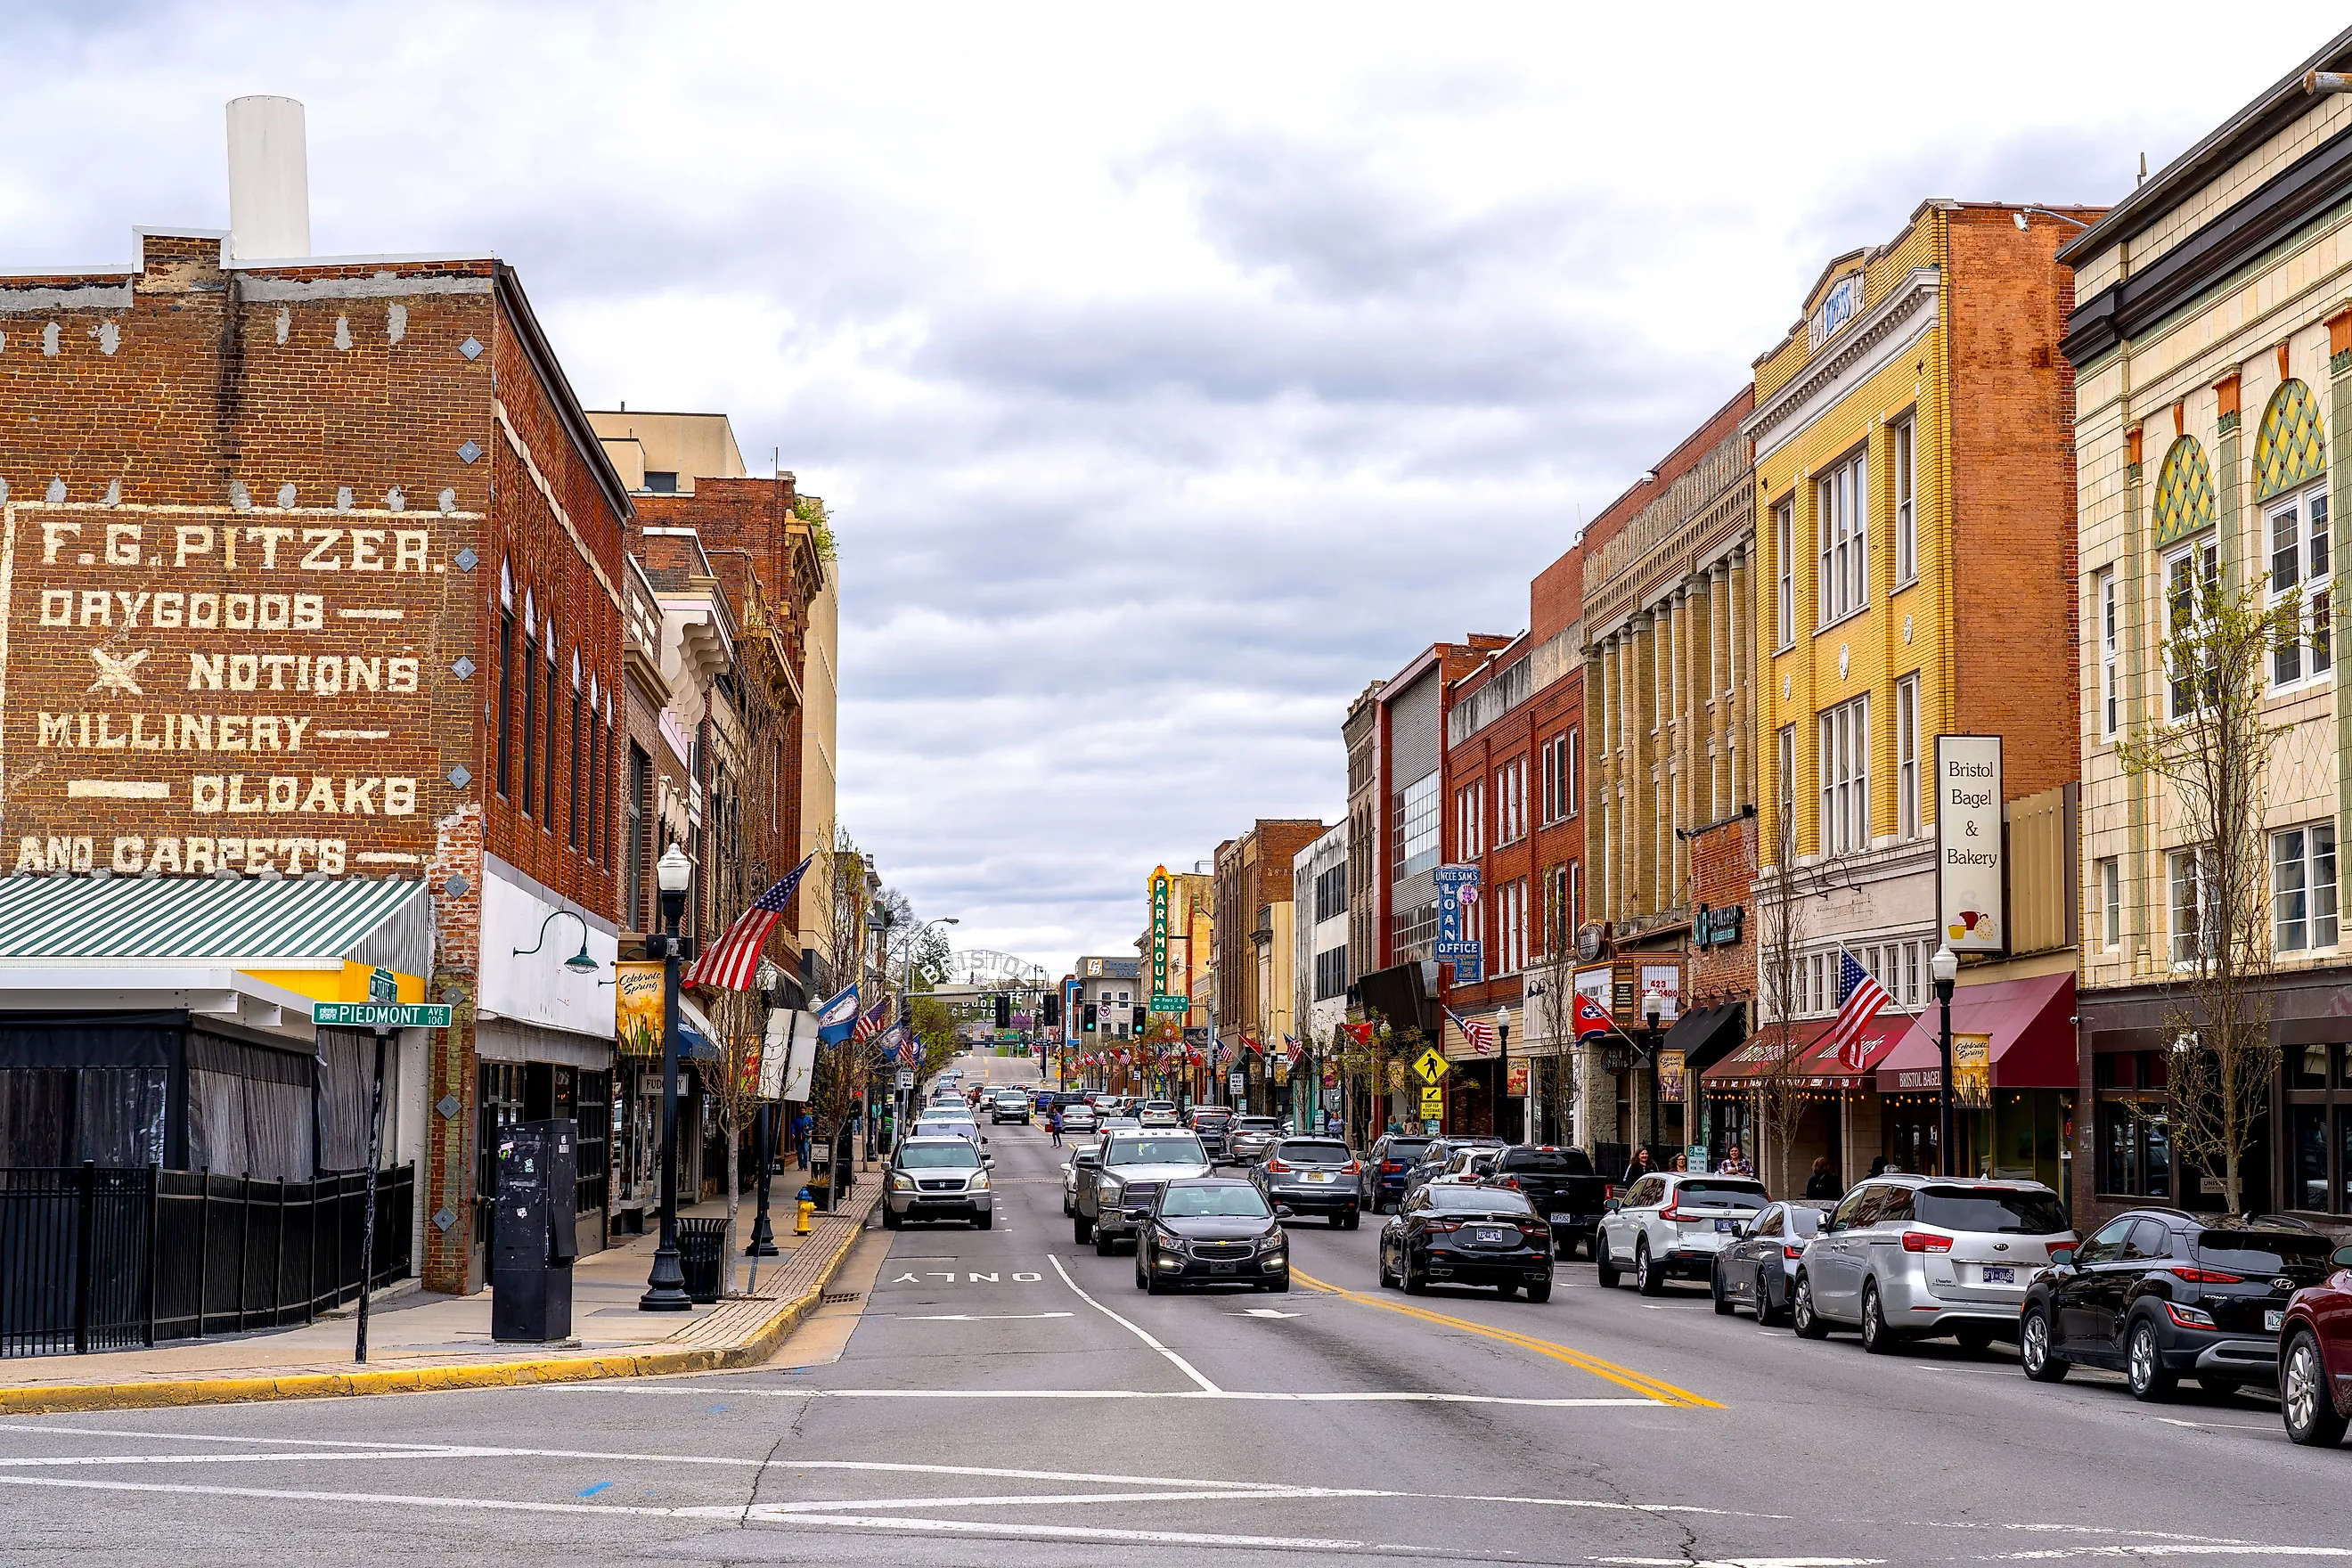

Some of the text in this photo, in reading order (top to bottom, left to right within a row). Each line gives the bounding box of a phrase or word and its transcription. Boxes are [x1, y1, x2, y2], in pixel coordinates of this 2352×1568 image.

[188, 653, 420, 696] NOTIONS
[37, 711, 313, 752] MILLINERY
[1948, 761, 1994, 779] Bristol
[192, 774, 416, 816] CLOAKS
[1951, 788, 1992, 809] Bagel
[1965, 820, 1980, 837] &
[12, 836, 347, 875] AND CARPETS
[1947, 848, 1997, 869] Bakery
[1435, 870, 1478, 881] UNCLE SAM'S
[1443, 883, 1456, 941] LOAN
[1154, 879, 1167, 997] PARAMOUN
[1438, 943, 1478, 953] OFFICE
[919, 949, 1032, 987] BRISTOL
[618, 970, 662, 986] Celebrate
[1650, 980, 1666, 988] 423
[376, 979, 390, 1000] STATE
[624, 981, 658, 996] Spring
[339, 1006, 421, 1025] PIEDMONT
[428, 1007, 445, 1017] AVE
[428, 1016, 444, 1025] 100
[1955, 1041, 1988, 1052] Celebrate
[1958, 1049, 1985, 1059] Spring
[1899, 1071, 1941, 1088] BRISTOL BAGEL
[1689, 1147, 1694, 1156] 2
[892, 1272, 1042, 1283] ONLY
[1983, 1270, 2013, 1281] BFV 0485
